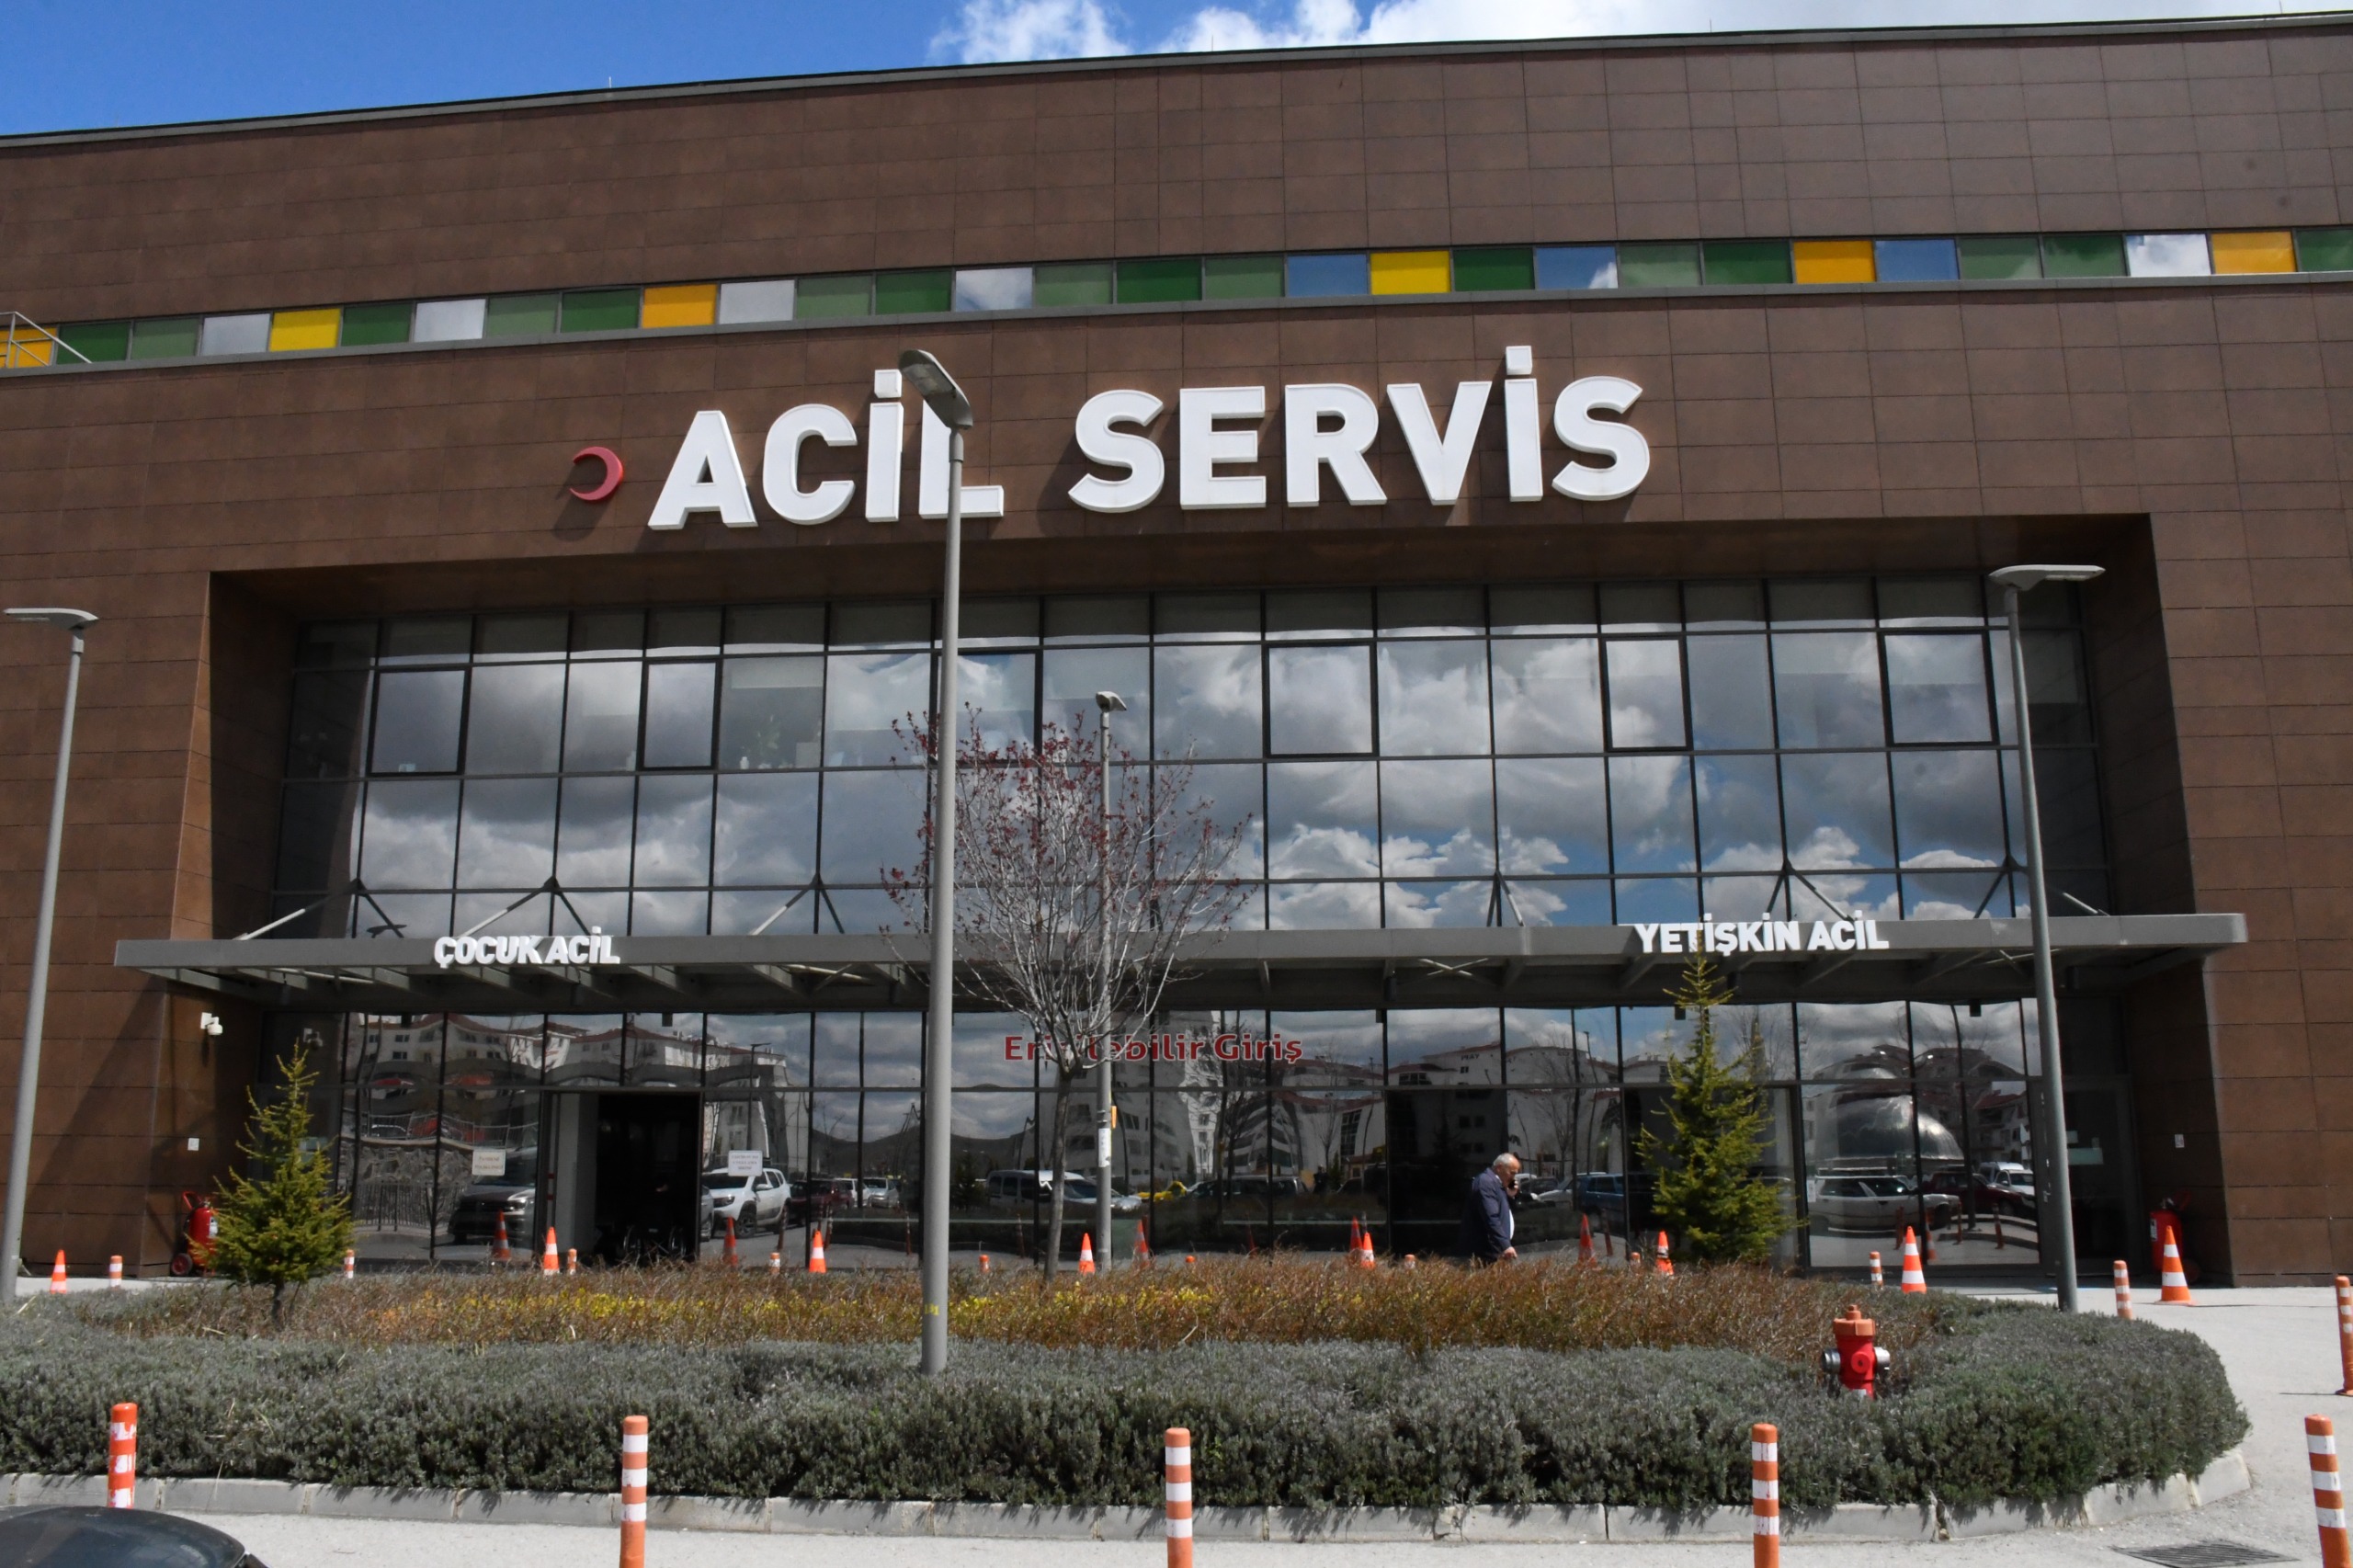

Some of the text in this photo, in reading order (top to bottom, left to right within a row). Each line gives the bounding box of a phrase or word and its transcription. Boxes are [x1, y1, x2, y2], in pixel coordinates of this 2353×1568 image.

[647, 346, 1651, 530] ACİL SERVİS
[434, 926, 621, 969] ÇOCUK ACİL
[1633, 910, 1890, 957] YETİŞKİN ACİL
[1213, 1033, 1303, 1064] Giriş
